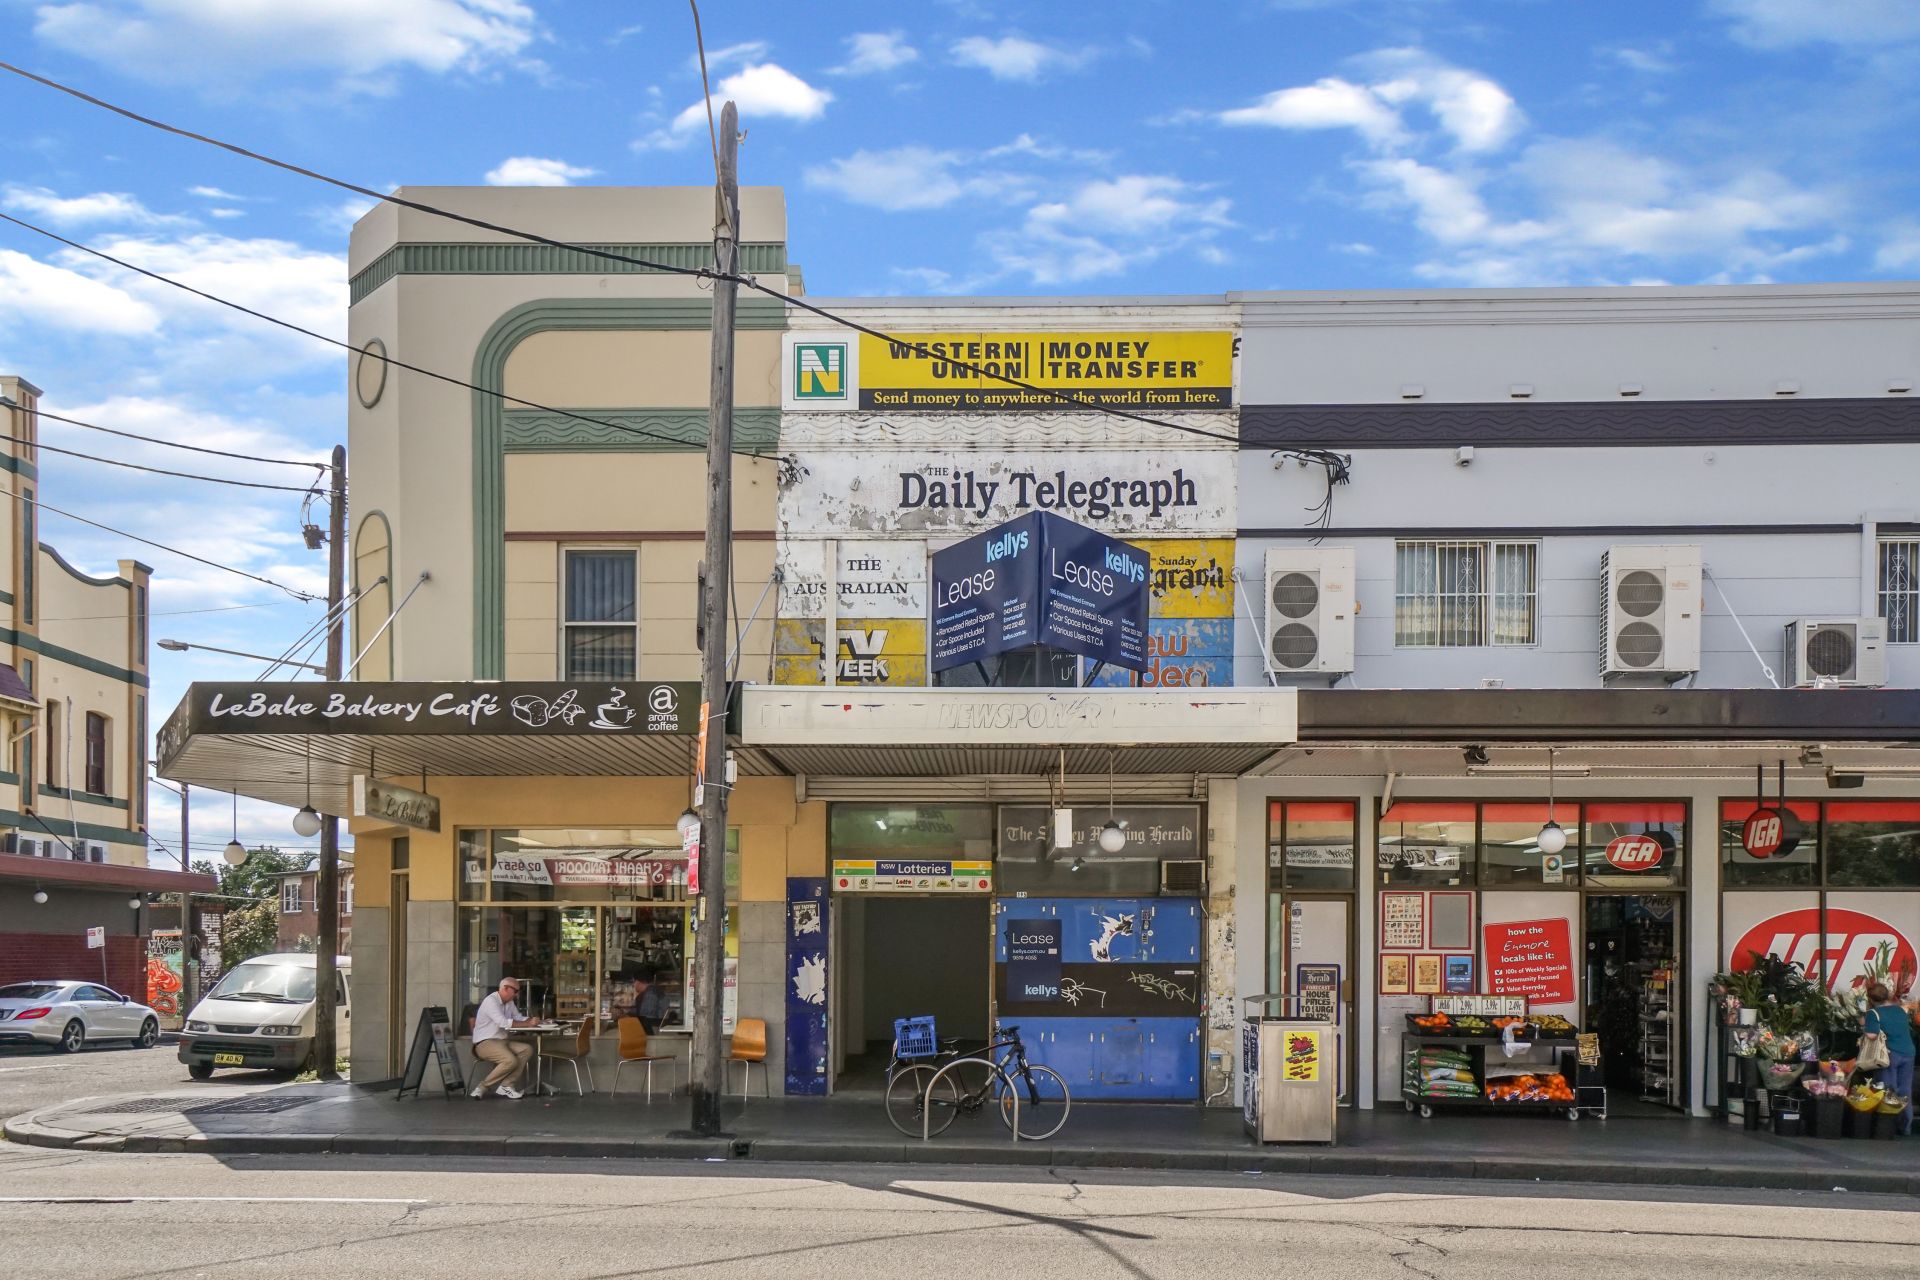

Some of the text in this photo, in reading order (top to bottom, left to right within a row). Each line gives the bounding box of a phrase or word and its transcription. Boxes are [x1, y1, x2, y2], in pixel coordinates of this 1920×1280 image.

[888, 342, 1150, 359] WESTERN MONEY
[931, 361, 1022, 379] UNION
[873, 391, 1220, 406] Send money to anywhere in the world from here.
[927, 467, 949, 476] THE
[899, 468, 1197, 519] Daily Telegraph
[986, 531, 1029, 563] kellys
[847, 559, 881, 571] THE
[1105, 546, 1145, 583] kellys
[1158, 555, 1198, 568] Sunday
[1052, 547, 1114, 596] Lease
[937, 568, 995, 608] Lease
[1056, 590, 1072, 600] Enmore
[1071, 595, 1082, 604] Road
[1081, 599, 1096, 608] Enmore
[954, 611, 964, 619] Road
[1053, 599, 1114, 626] Renovated Retail Space
[938, 612, 995, 636] Renovated Retail Space
[1052, 612, 1104, 635] Car Space Included
[938, 625, 985, 647] Car Space Included
[1052, 624, 1073, 638] Various
[1073, 630, 1087, 642] Uses
[938, 646, 957, 658] Various
[956, 643, 969, 653] Uses
[210, 691, 501, 725] LeBake Bakery Café
[940, 702, 1102, 729] NEWSPOWR
[648, 722, 679, 731] coffee
[1006, 826, 1193, 845] The Sey Ming Herald
[1748, 816, 1780, 849] IGA
[1611, 842, 1656, 862] IGA
[898, 864, 947, 874] Lotteries
[1012, 932, 1054, 945] Lease
[1507, 926, 1543, 936] how the
[1503, 940, 1550, 952] Enmore
[1501, 952, 1555, 963] locals like it:
[1525, 966, 1545, 974] Weekly
[1545, 964, 1568, 972] Specials
[1506, 976, 1536, 984] Community
[1025, 985, 1058, 997] kellys
